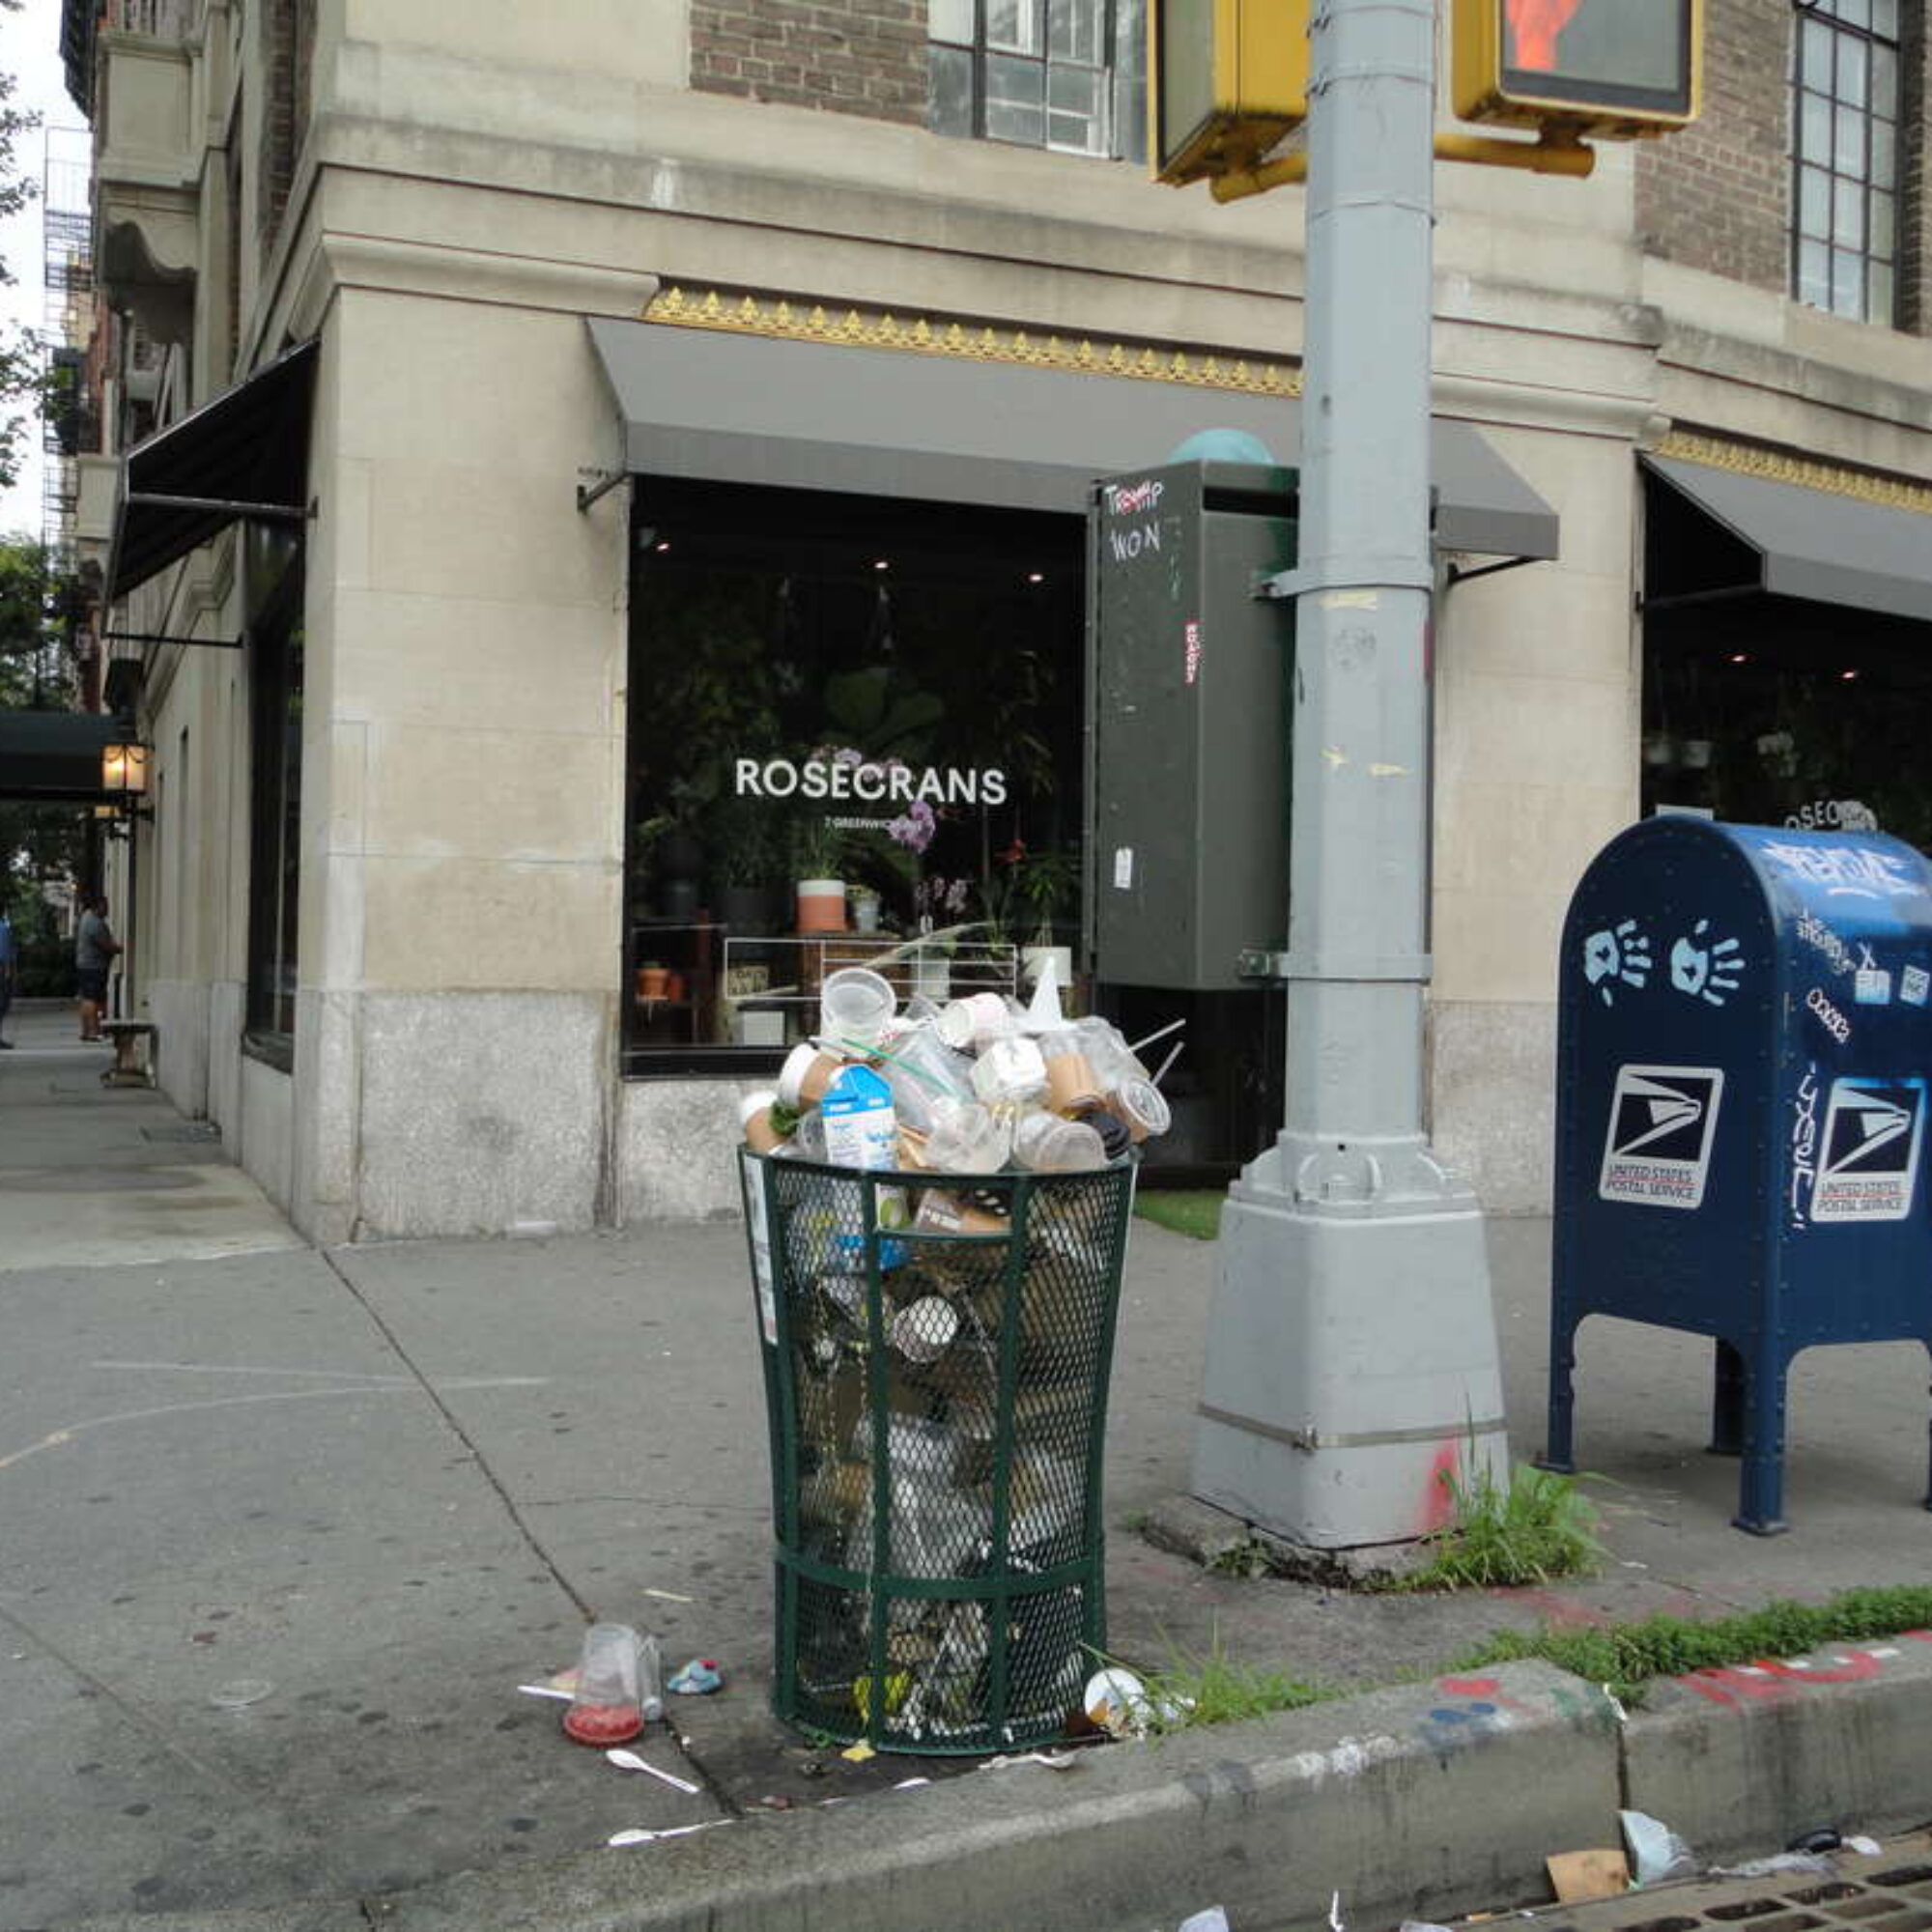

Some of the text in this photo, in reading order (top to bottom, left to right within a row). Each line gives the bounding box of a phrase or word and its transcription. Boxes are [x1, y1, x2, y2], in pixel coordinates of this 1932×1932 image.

[1110, 522, 1160, 561] WON
[735, 758, 1008, 805] ROSECRANS
[1608, 1164, 1692, 1183] UNITED STATES
[1605, 1181, 1696, 1200] POSTAL SERVICE
[1820, 1180, 1900, 1196] UNITED STATES
[1816, 1198, 1902, 1212] POSTAL SERVICE
